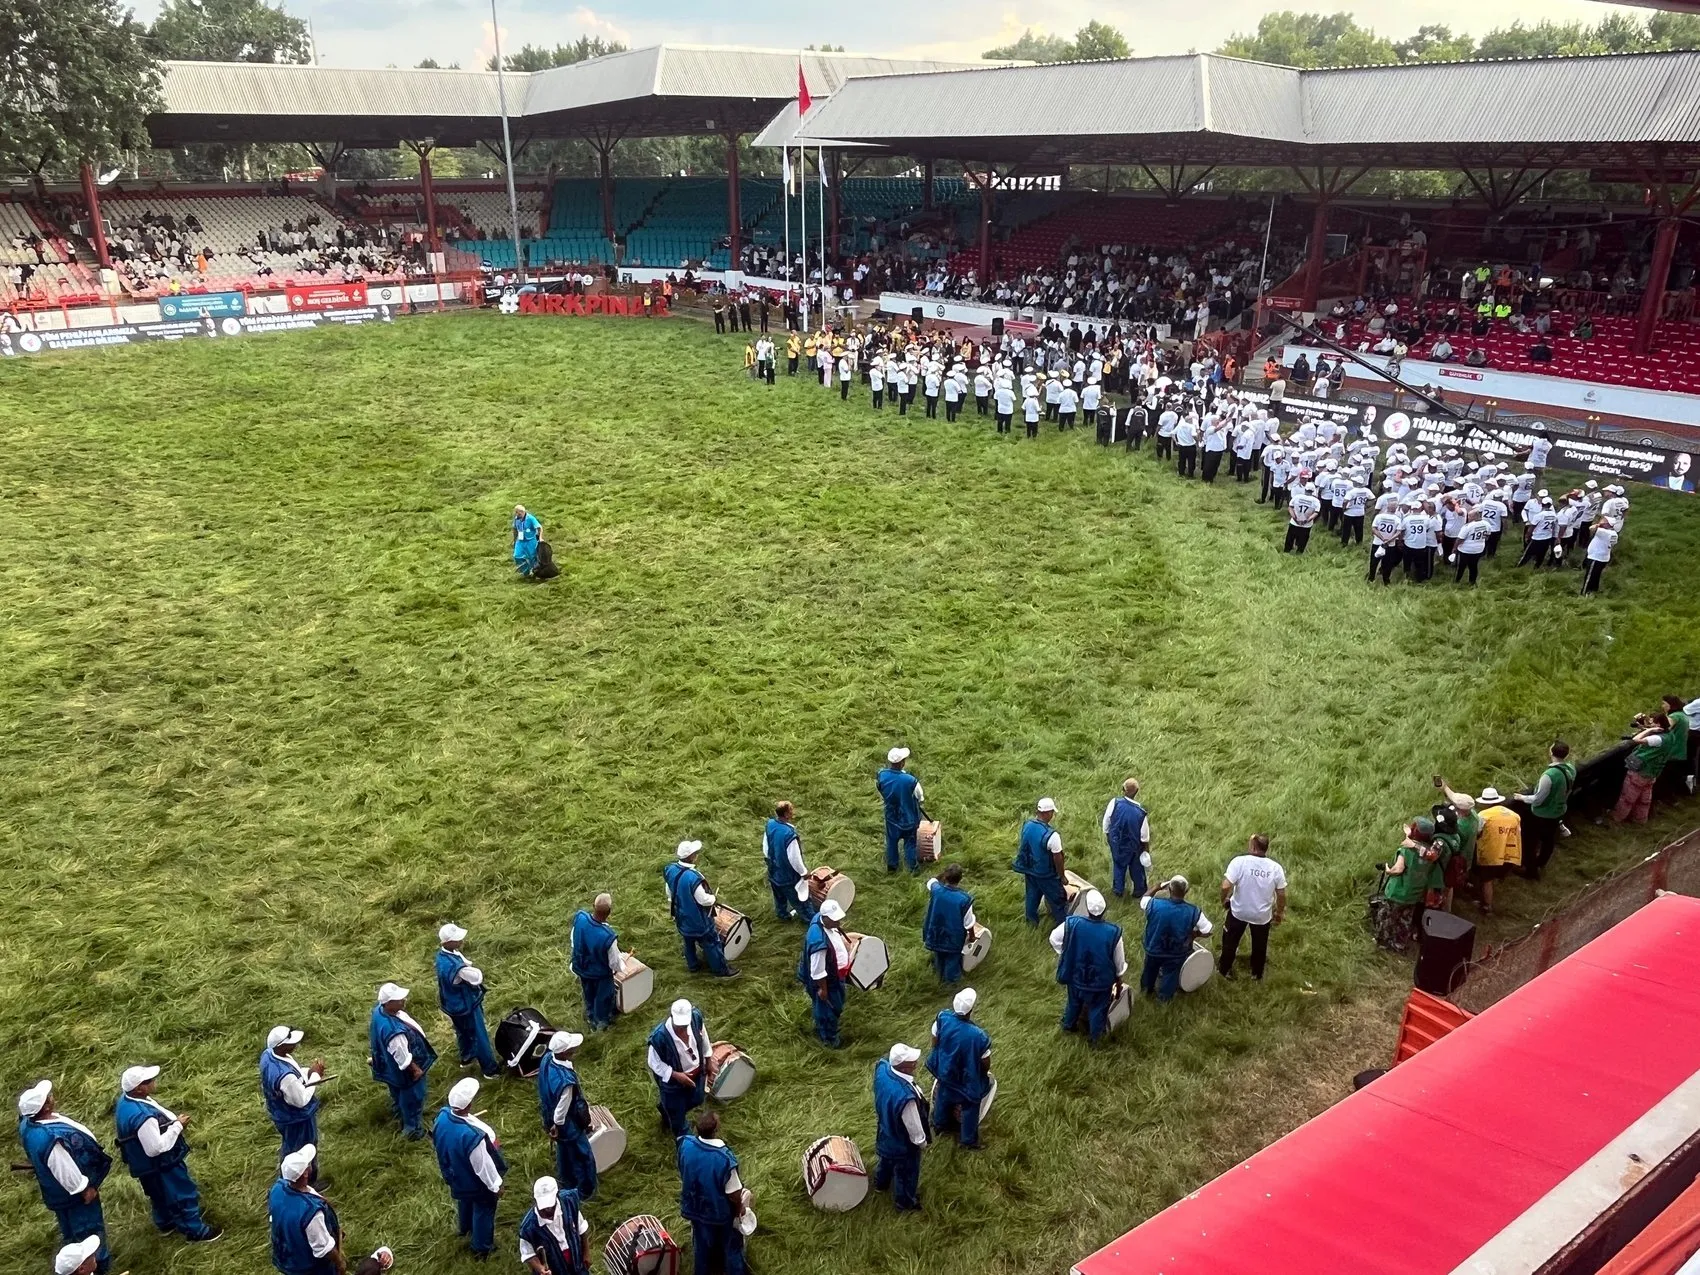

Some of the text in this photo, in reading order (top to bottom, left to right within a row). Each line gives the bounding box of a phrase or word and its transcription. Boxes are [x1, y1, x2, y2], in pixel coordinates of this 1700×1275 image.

[1564, 450, 1591, 461] Dünya
[1334, 488, 1346, 498] 83
[1298, 505, 1309, 513] 17
[1483, 509, 1496, 519] 22
[1380, 523, 1393, 533] 20
[1410, 525, 1424, 534] 39
